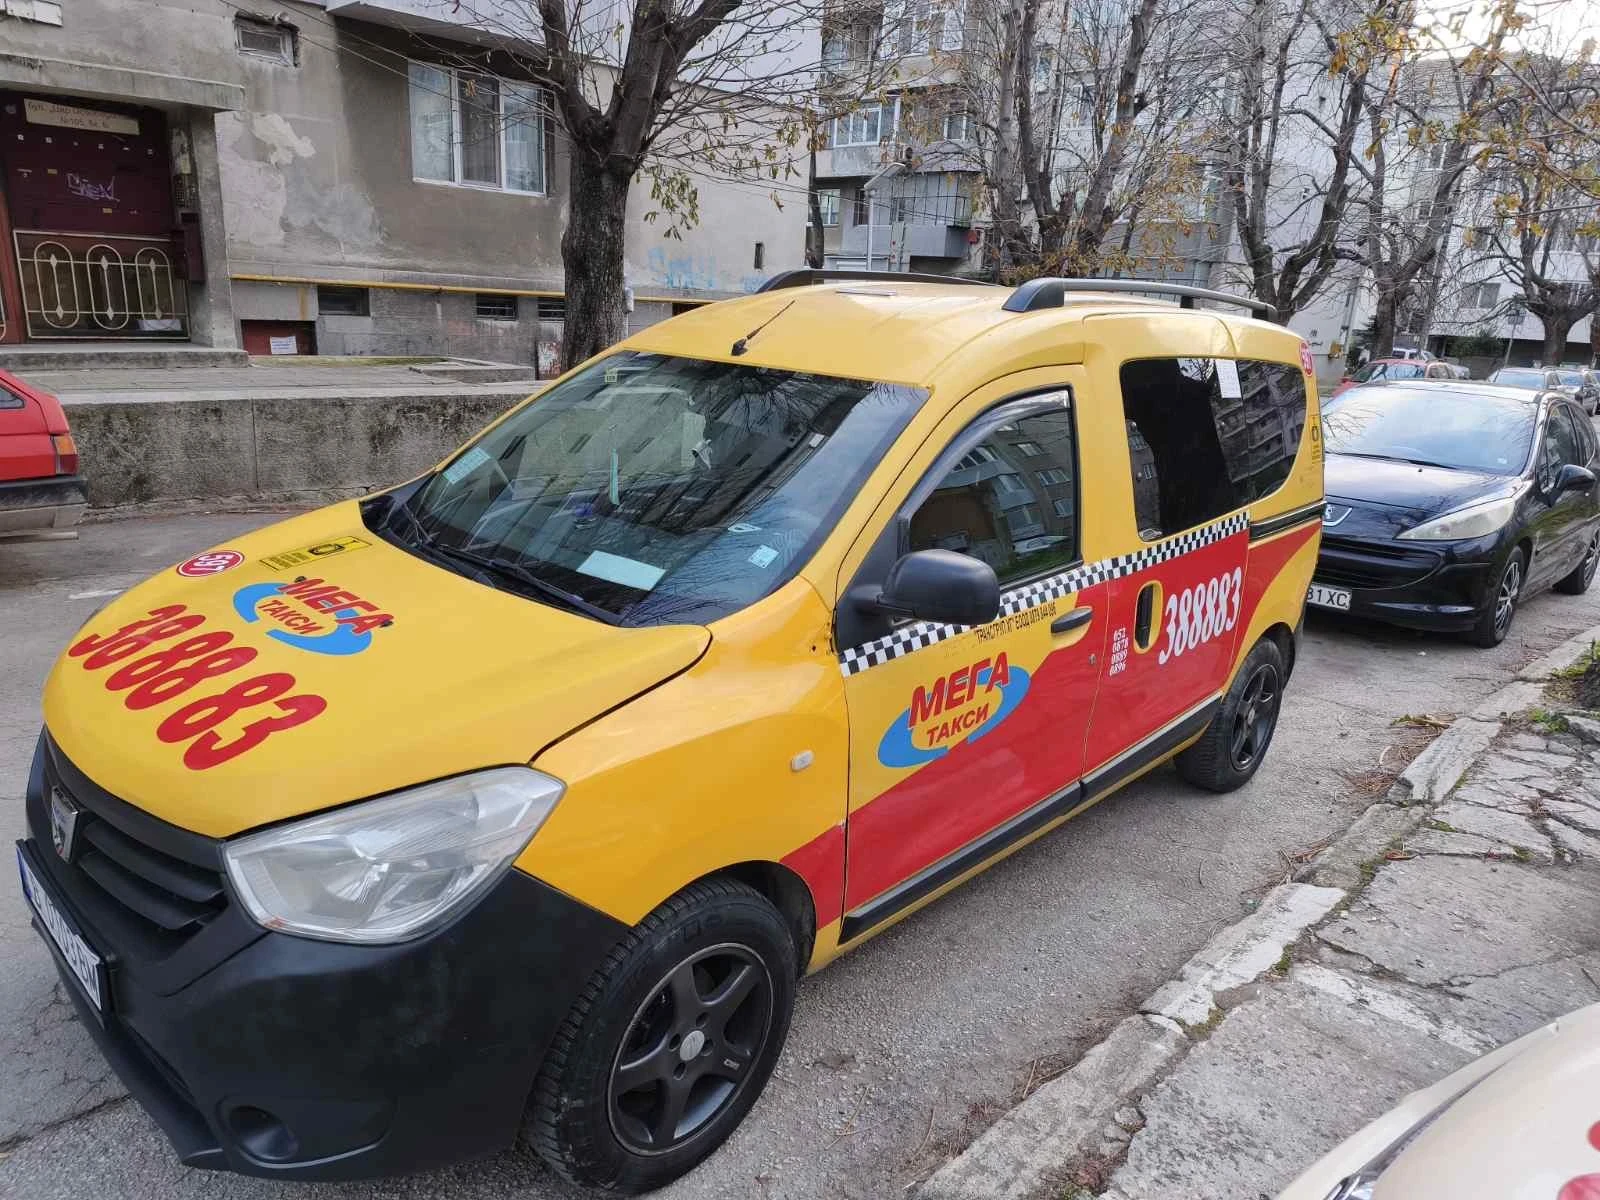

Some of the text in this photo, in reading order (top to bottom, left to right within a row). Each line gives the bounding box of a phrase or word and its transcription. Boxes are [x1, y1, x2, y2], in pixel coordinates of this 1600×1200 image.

[257, 599, 324, 634] ТАКСИ
[277, 578, 394, 634] МЕГА
[1159, 566, 1242, 665] 388883
[68, 604, 327, 770] 388883
[909, 651, 1010, 729] МЕГА
[926, 703, 989, 747] ТАКСИ
